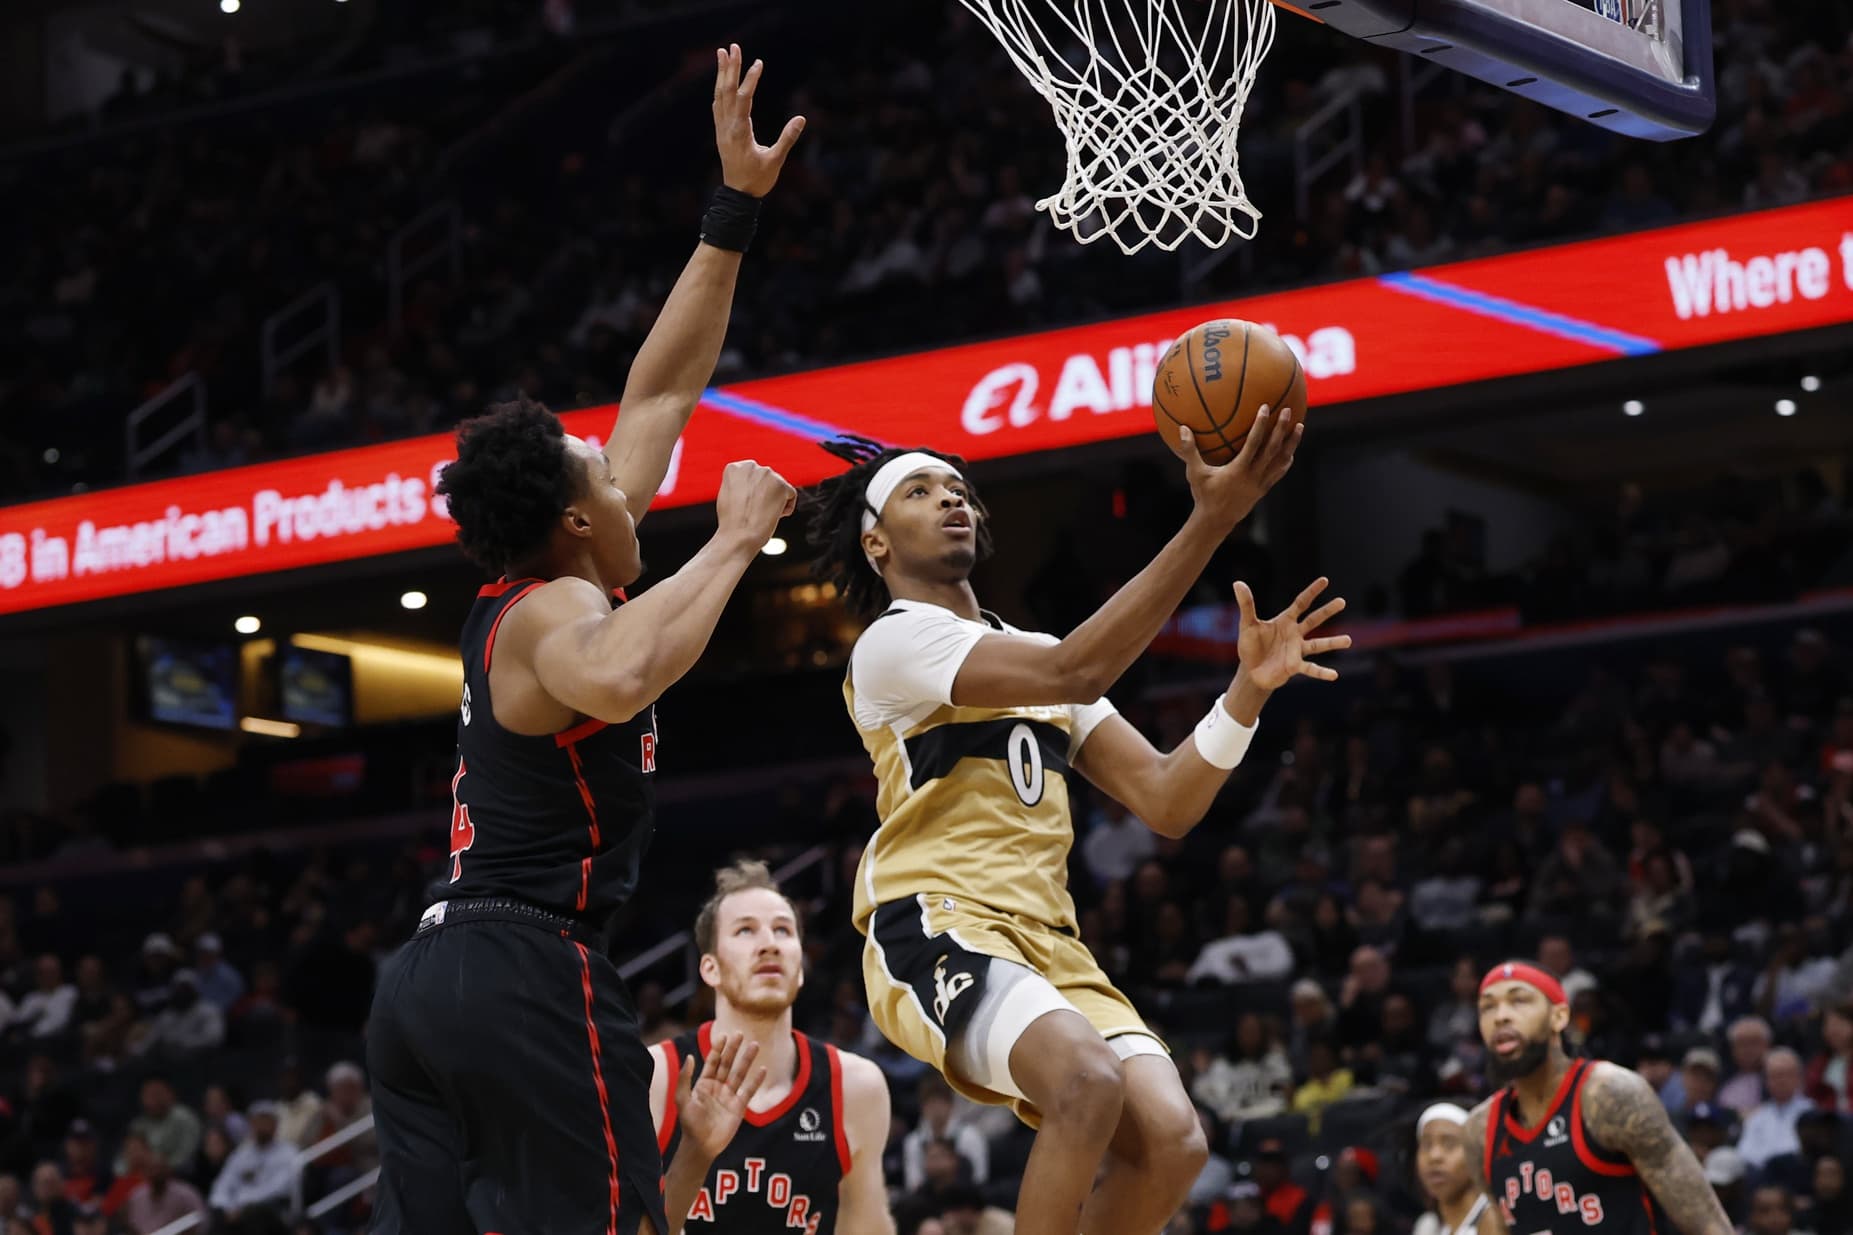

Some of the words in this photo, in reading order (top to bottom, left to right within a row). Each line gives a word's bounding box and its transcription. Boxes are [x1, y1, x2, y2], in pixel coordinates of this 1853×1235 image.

[1664, 247, 1830, 320] Where
[1203, 321, 1232, 383] ilson
[31, 527, 69, 583] in
[72, 505, 249, 578] American
[253, 472, 427, 548] Products
[1007, 723, 1045, 807] 0
